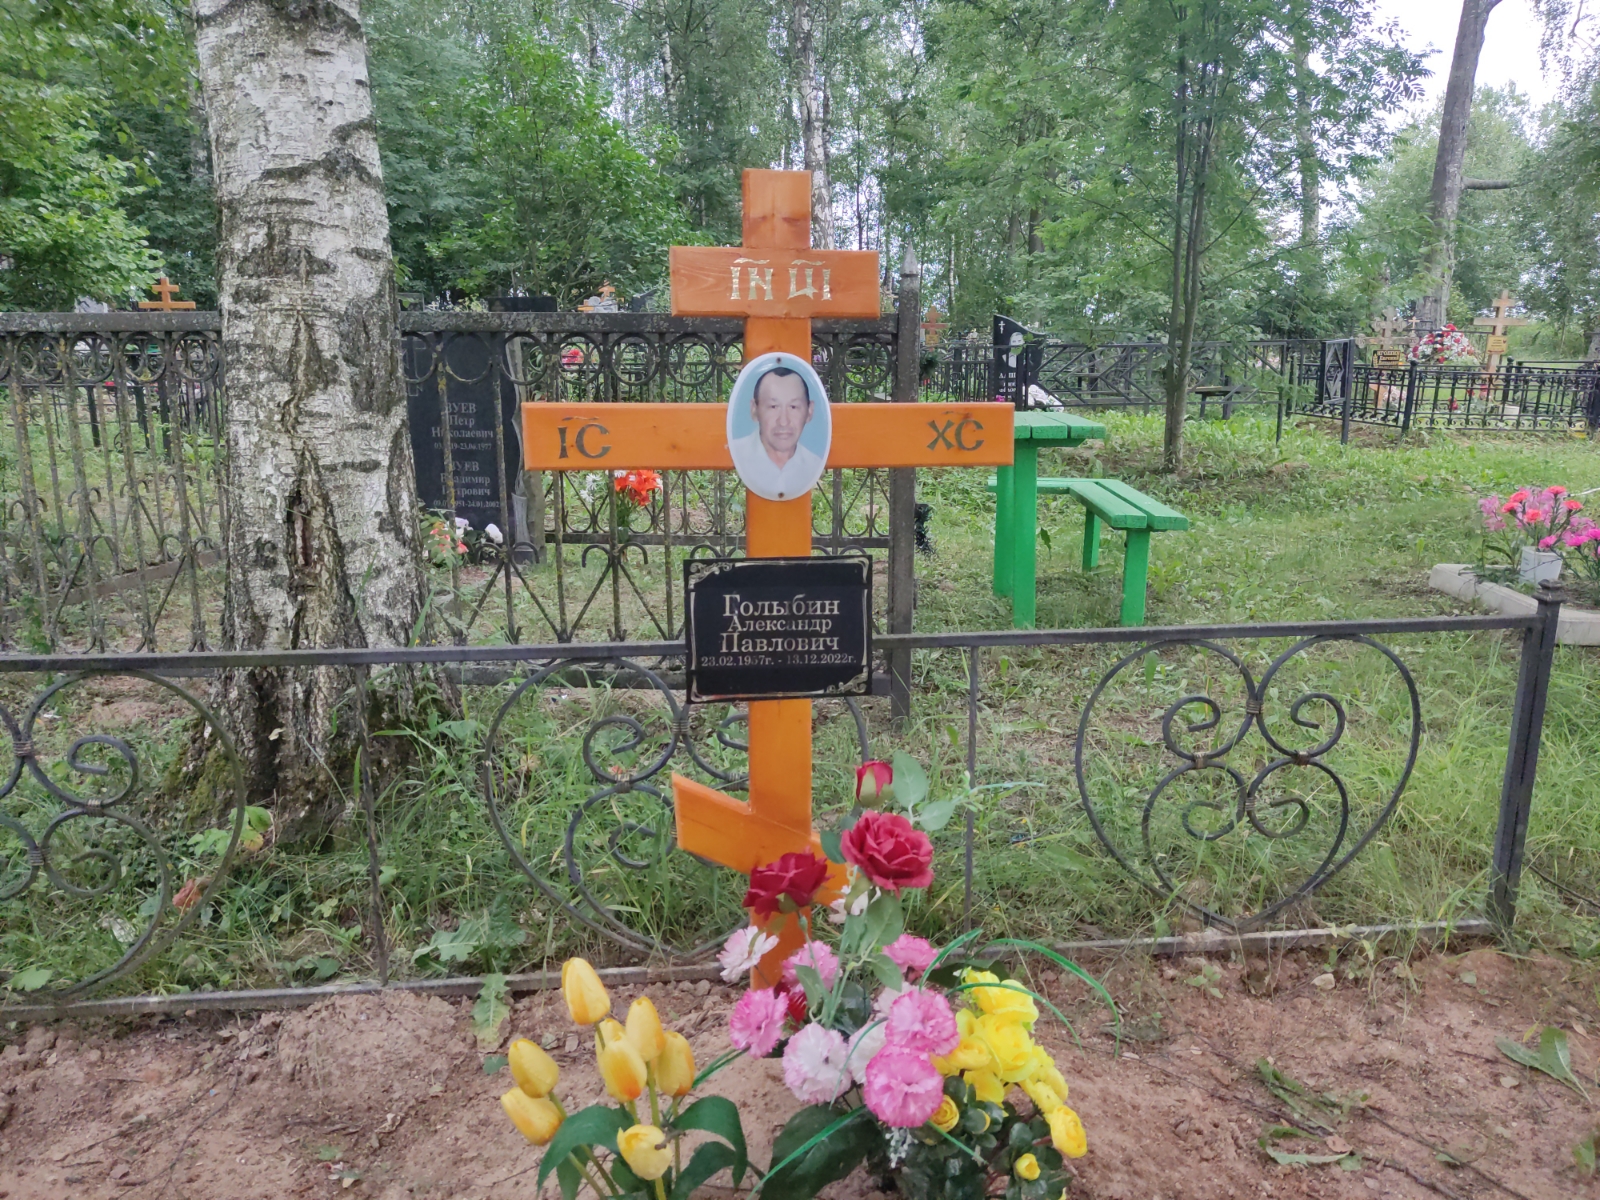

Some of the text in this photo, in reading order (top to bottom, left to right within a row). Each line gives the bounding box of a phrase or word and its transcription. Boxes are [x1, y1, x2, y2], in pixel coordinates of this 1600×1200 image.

[449, 414, 475, 428] Петр
[431, 426, 494, 439] Нколаевич
[440, 472, 491, 486] Вадимир
[722, 592, 841, 617] Голыбин
[727, 614, 833, 634] Александр
[720, 632, 840, 653] Павлович
[787, 653, 857, 665] 13.12.2022г.
